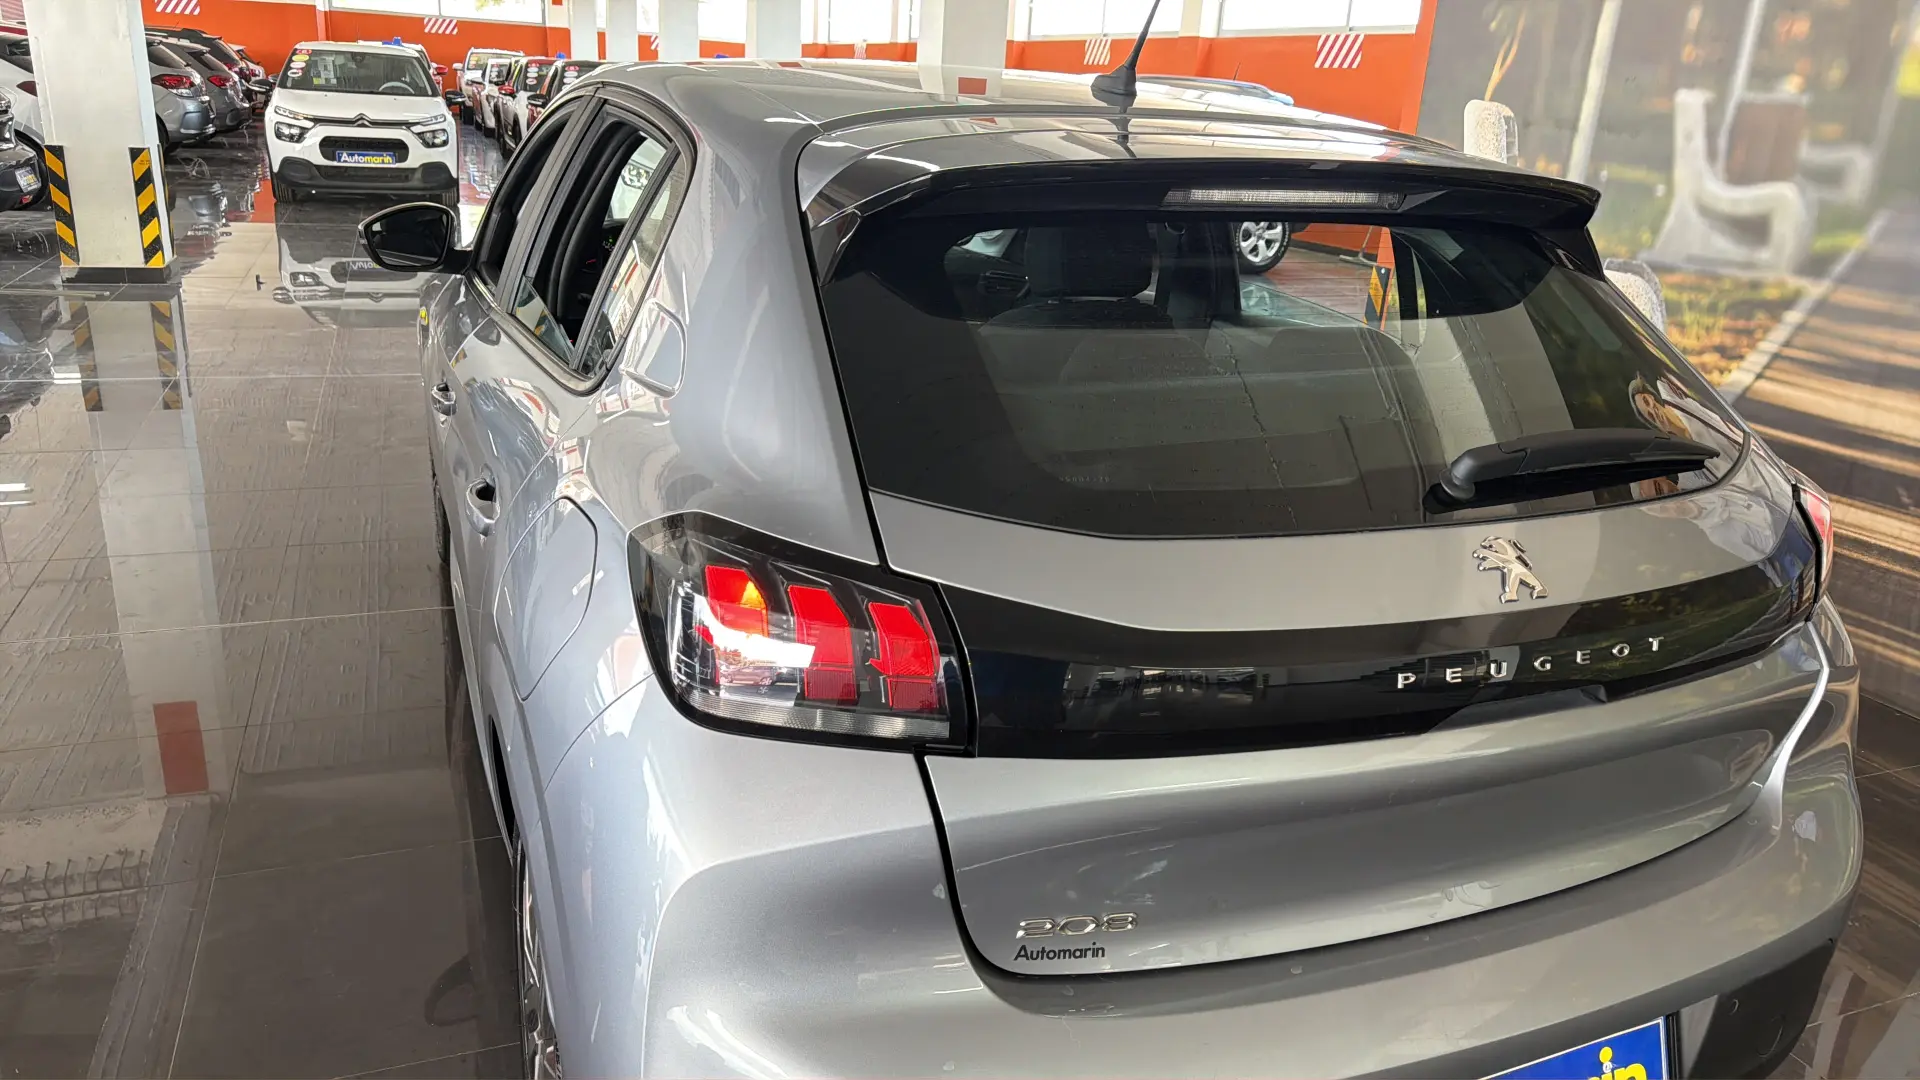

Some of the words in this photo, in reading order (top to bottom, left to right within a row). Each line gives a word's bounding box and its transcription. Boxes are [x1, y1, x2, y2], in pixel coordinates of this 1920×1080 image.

[340, 152, 393, 164] Automarin
[1397, 636, 1665, 689] PEUGEOT
[1016, 912, 1139, 939] 208
[1013, 942, 1106, 961] Automarin
